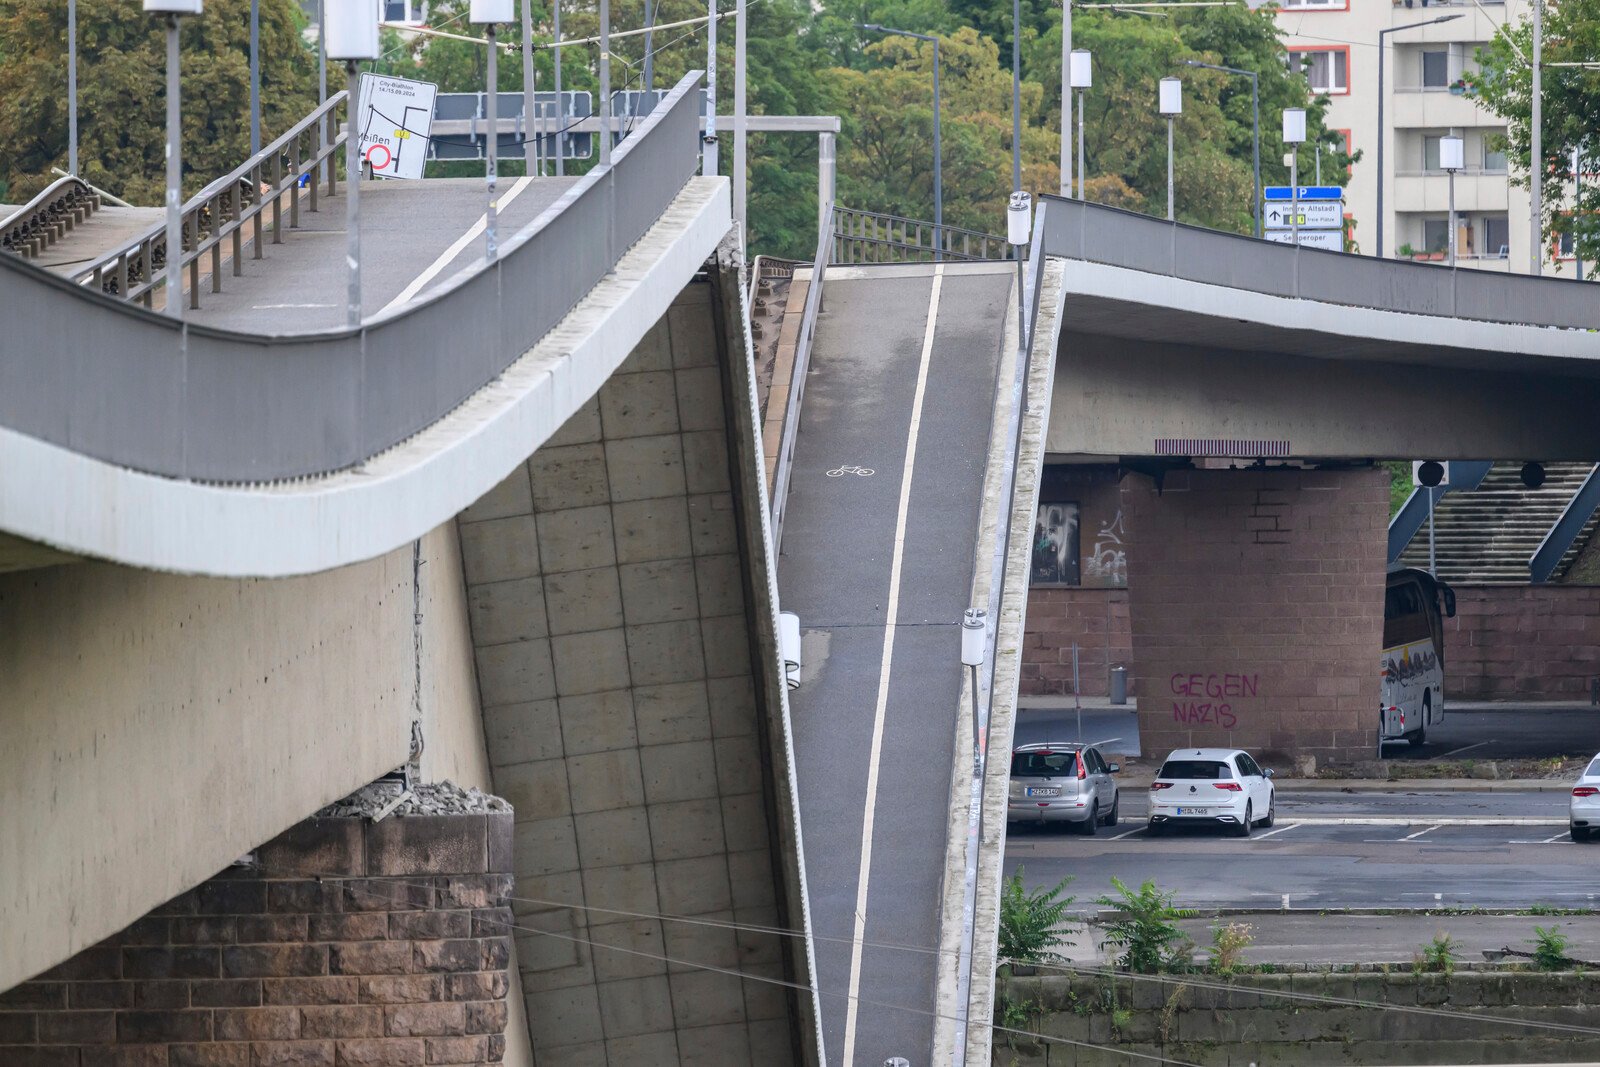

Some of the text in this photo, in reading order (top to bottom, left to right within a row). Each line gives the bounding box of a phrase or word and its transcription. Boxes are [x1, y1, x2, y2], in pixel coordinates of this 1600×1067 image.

[379, 80, 414, 90] City-Biathlon
[1300, 188, 1307, 199] P
[1283, 234, 1326, 242] Seperoper
[1170, 673, 1258, 700] GEGEN
[1173, 701, 1237, 728] NAZIS
